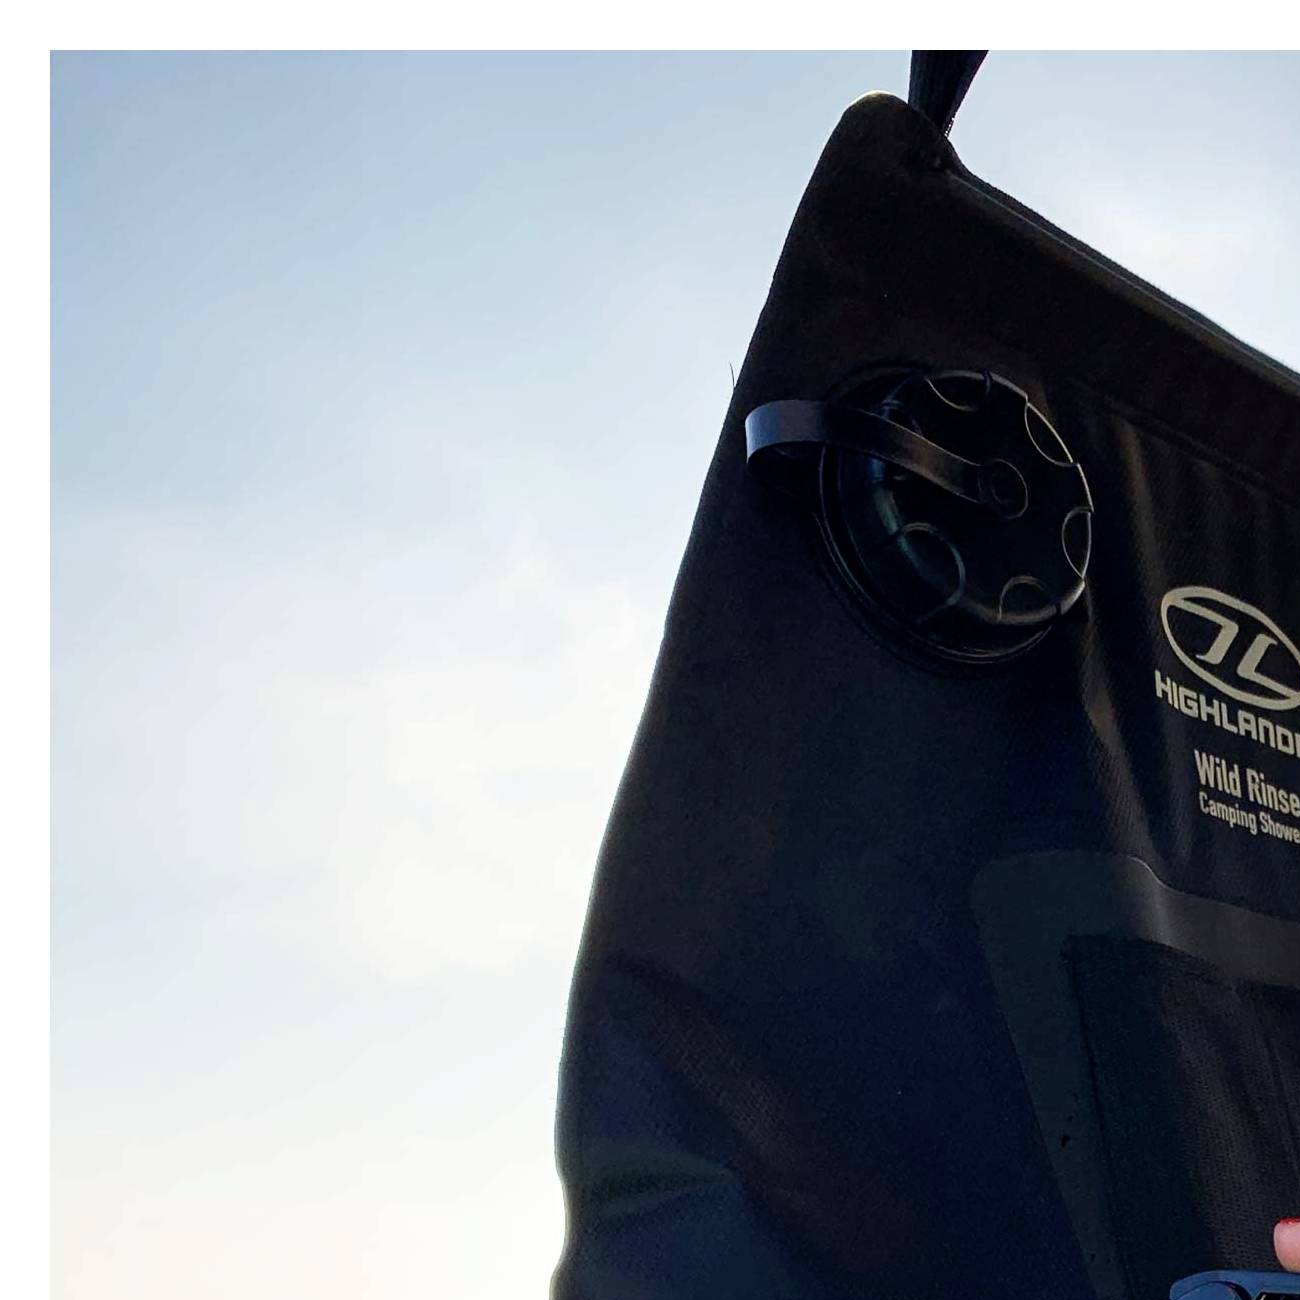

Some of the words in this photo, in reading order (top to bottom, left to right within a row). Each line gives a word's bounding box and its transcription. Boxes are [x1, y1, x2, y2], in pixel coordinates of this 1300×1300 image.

[1194, 750, 1241, 798] Wild
[1248, 768, 1300, 817] Rinse
[1199, 791, 1257, 835] Camping
